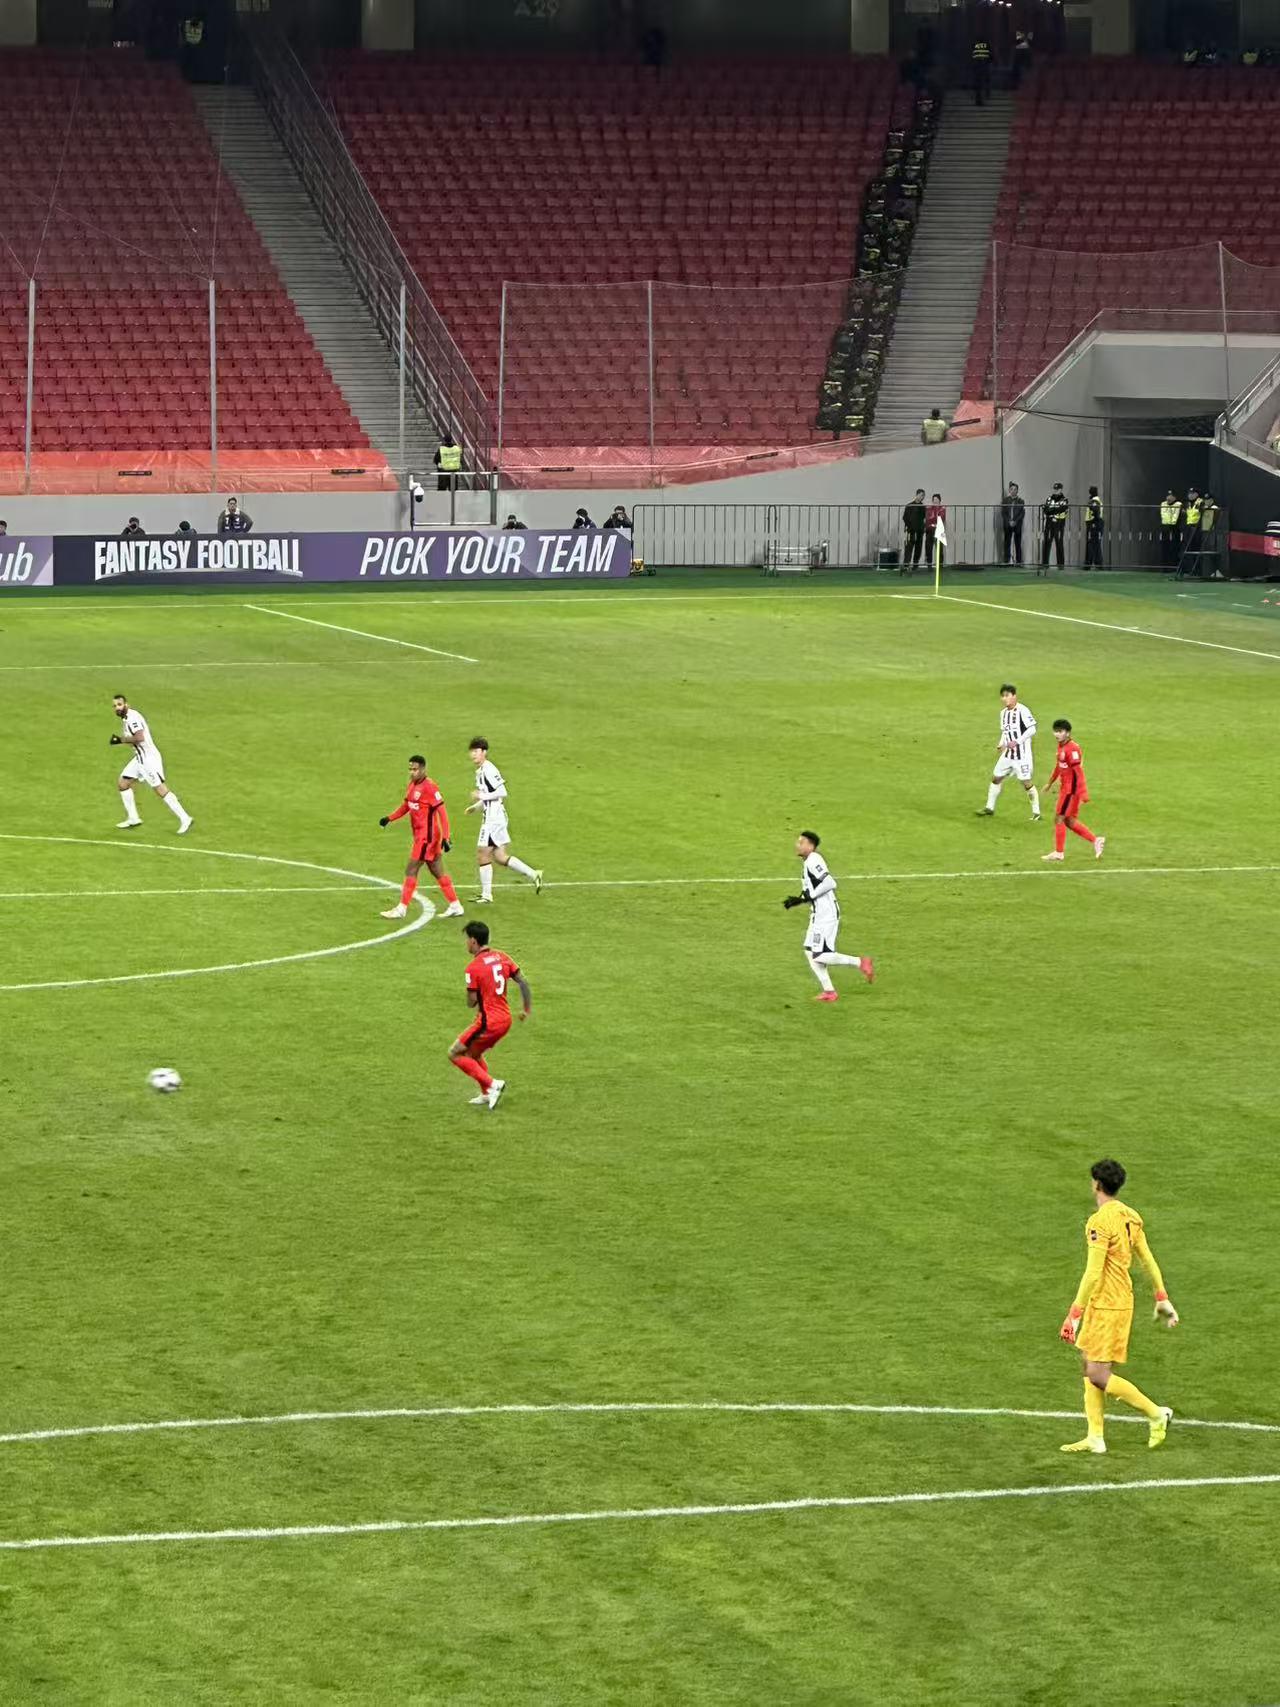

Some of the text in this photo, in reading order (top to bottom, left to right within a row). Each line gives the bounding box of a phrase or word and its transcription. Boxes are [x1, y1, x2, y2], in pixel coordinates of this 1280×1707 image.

[94, 538, 303, 580] FANTASY FOOTBALL
[359, 534, 618, 576] PICK YOUR TEAM
[491, 963, 505, 996] 5
